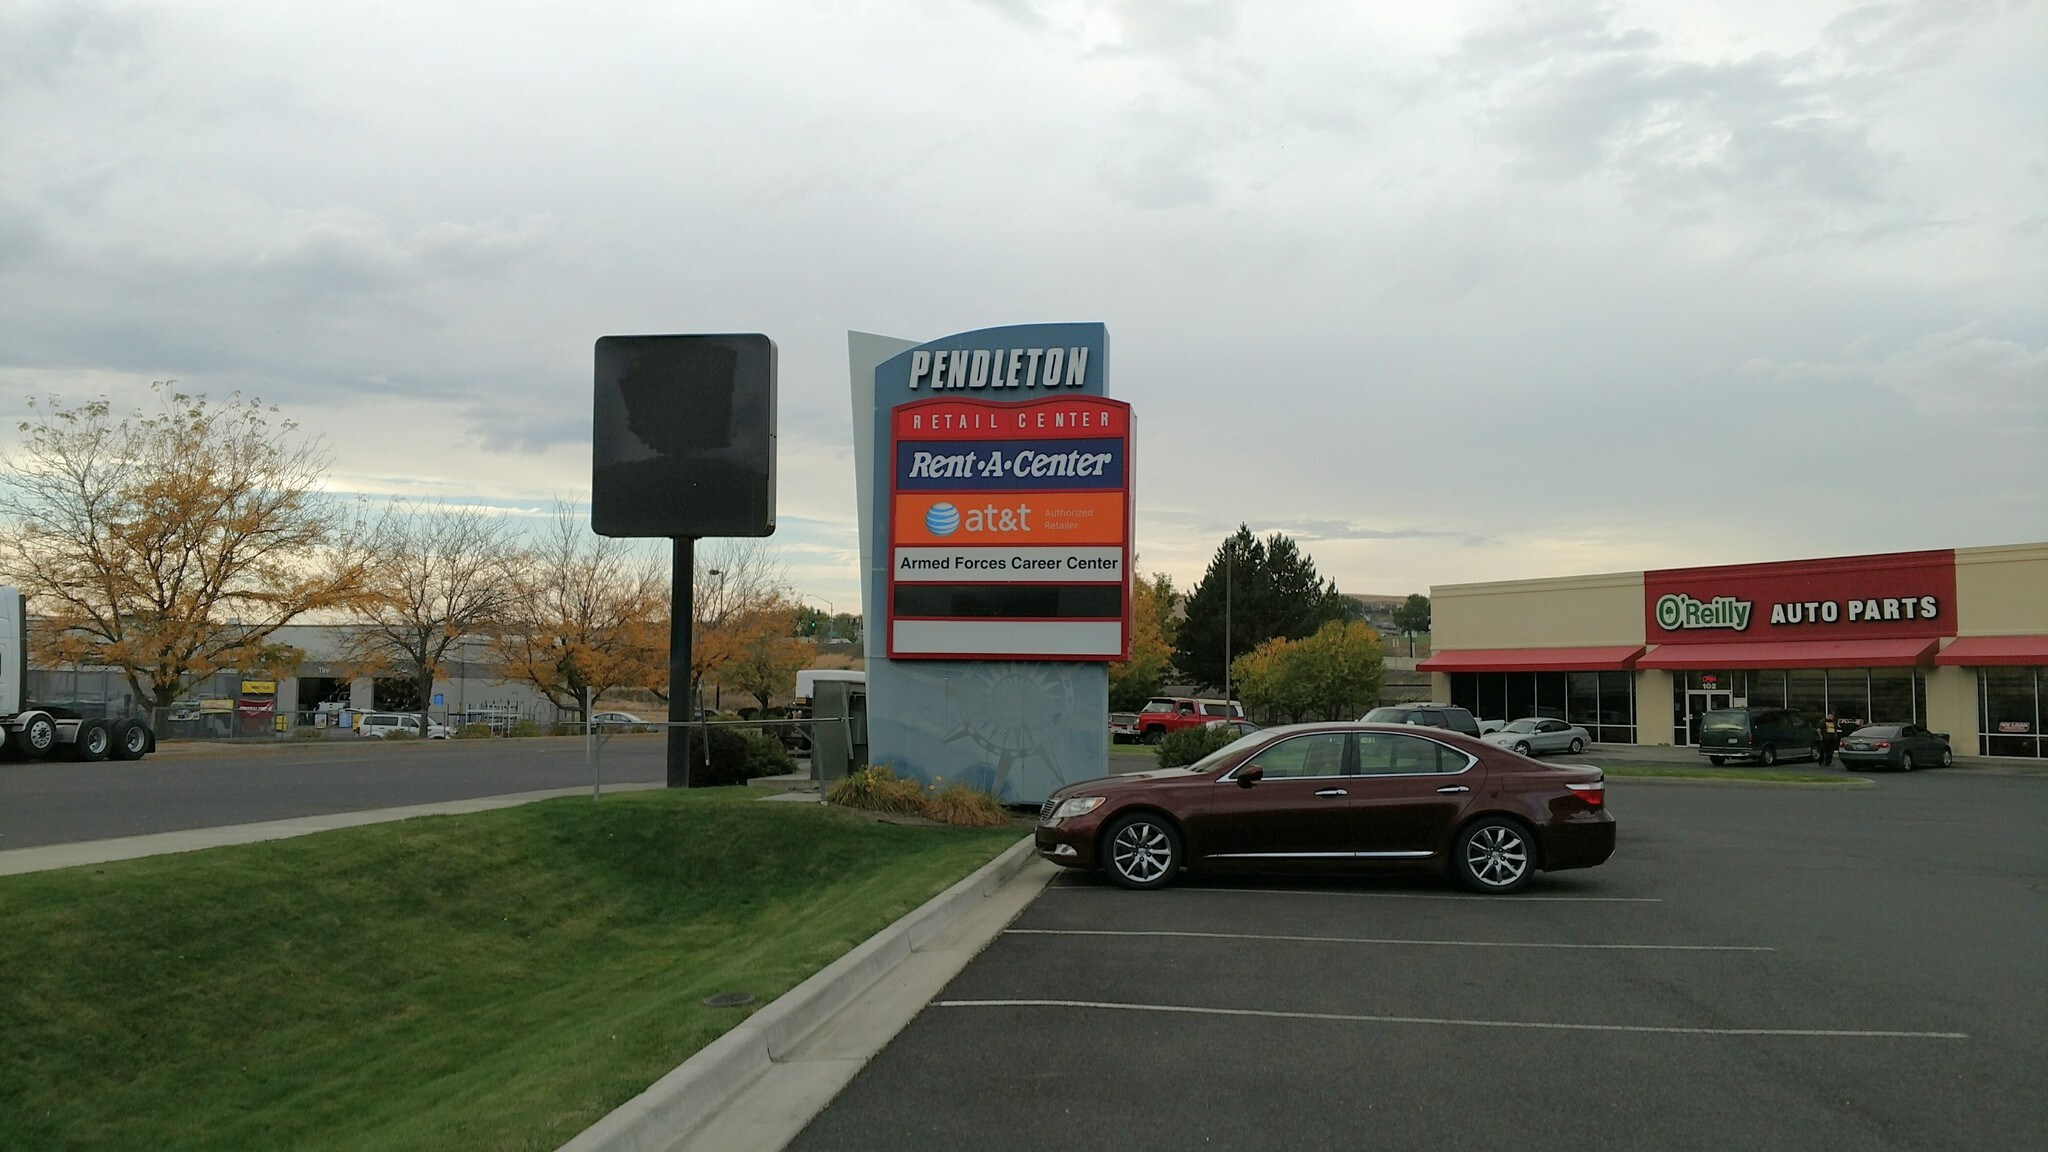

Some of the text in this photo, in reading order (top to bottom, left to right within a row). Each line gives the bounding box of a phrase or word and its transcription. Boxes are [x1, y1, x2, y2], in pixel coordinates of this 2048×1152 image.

[908, 347, 1089, 388] PENDLETON
[913, 411, 1109, 430] RETAIL CENTER
[964, 503, 1031, 532] at&t
[1044, 508, 1094, 517] Authorized
[1044, 521, 1079, 530] Retailer
[900, 556, 1119, 570] Armed Forces Career Center
[1656, 594, 1938, 630] O'Reilly AUTO PARTS
[1702, 682, 1717, 690] 102
